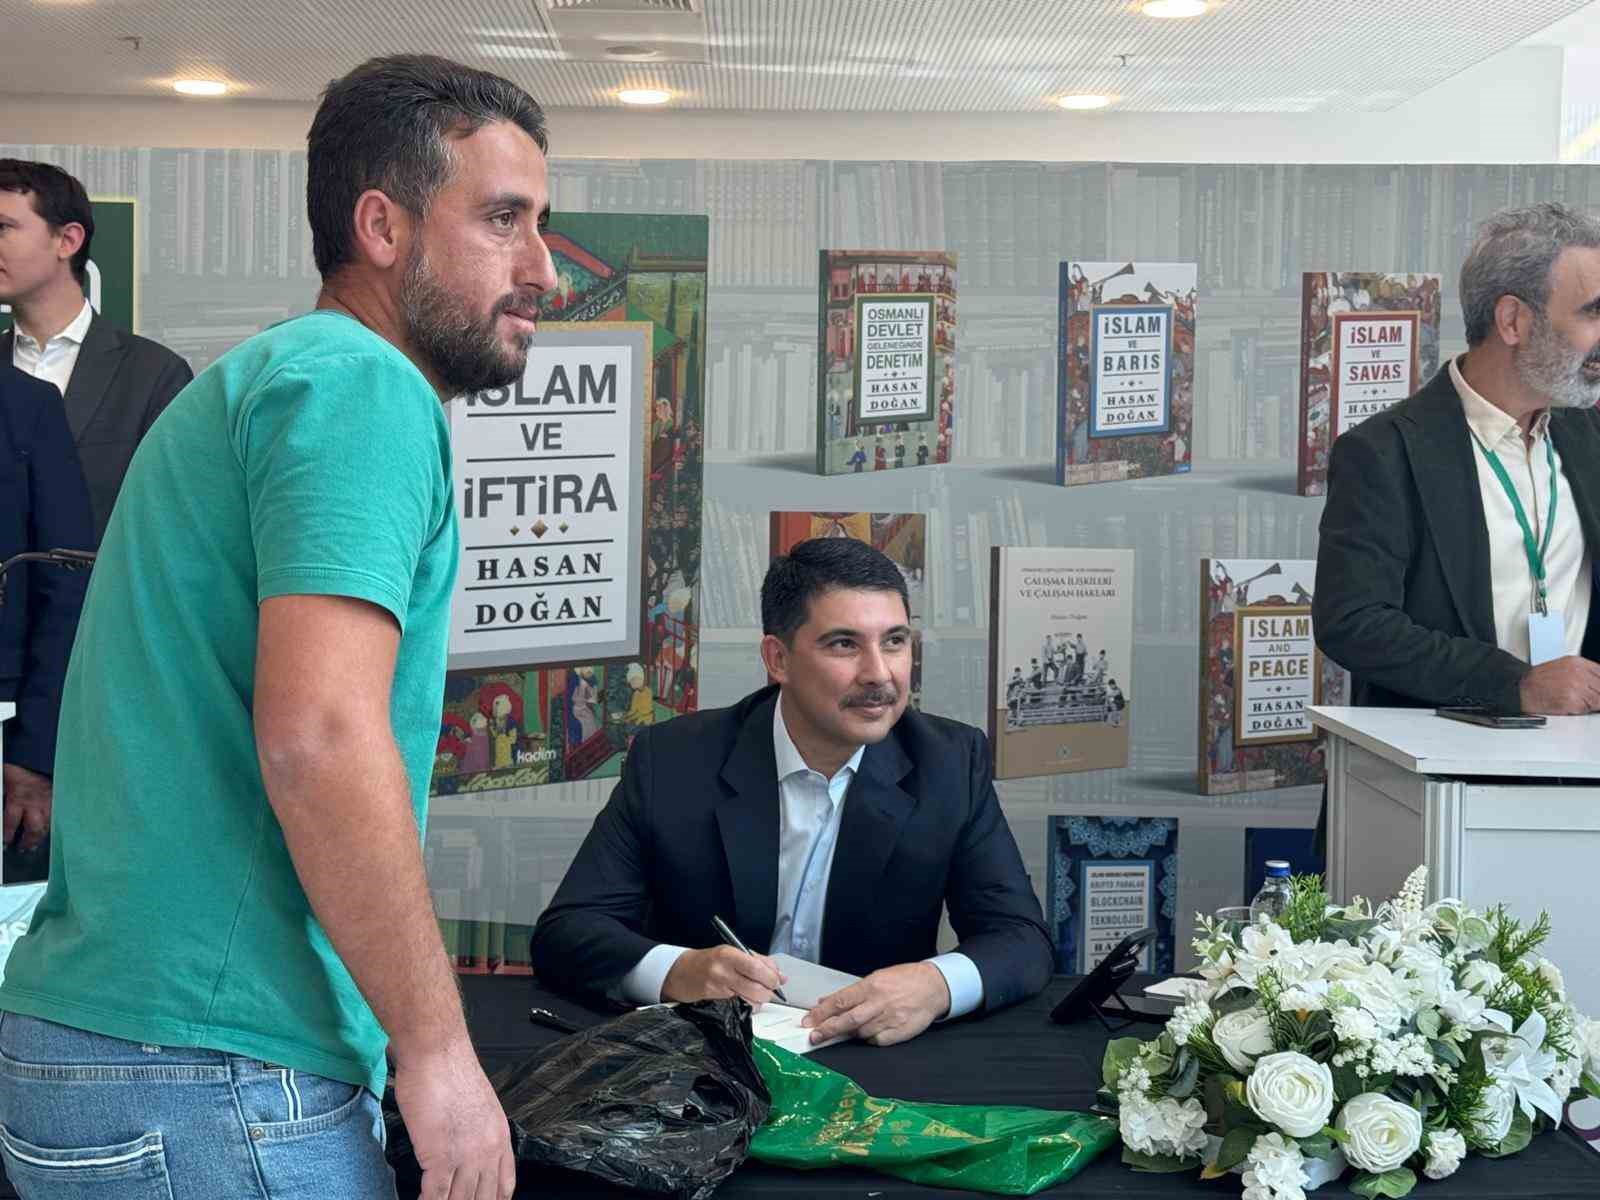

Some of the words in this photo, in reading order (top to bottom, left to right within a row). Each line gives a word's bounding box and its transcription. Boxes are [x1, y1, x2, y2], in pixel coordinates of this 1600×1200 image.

[868, 308, 924, 321] OSMANLI
[867, 323, 923, 337] DEVLET
[1128, 340, 1137, 348] VE
[1371, 350, 1380, 359] VE
[871, 382, 918, 393] HASAN
[870, 397, 919, 410] DOĞAN
[1107, 394, 1155, 406] HASAN
[1106, 410, 1155, 422] DOĞAN
[520, 422, 563, 451] VE
[477, 552, 603, 581] HASAN
[476, 592, 603, 626] DOĞAN
[1268, 643, 1290, 654] AND
[1249, 659, 1309, 678] PEACE
[1253, 700, 1305, 713] HASAN
[1252, 716, 1304, 730] DOĞAN
